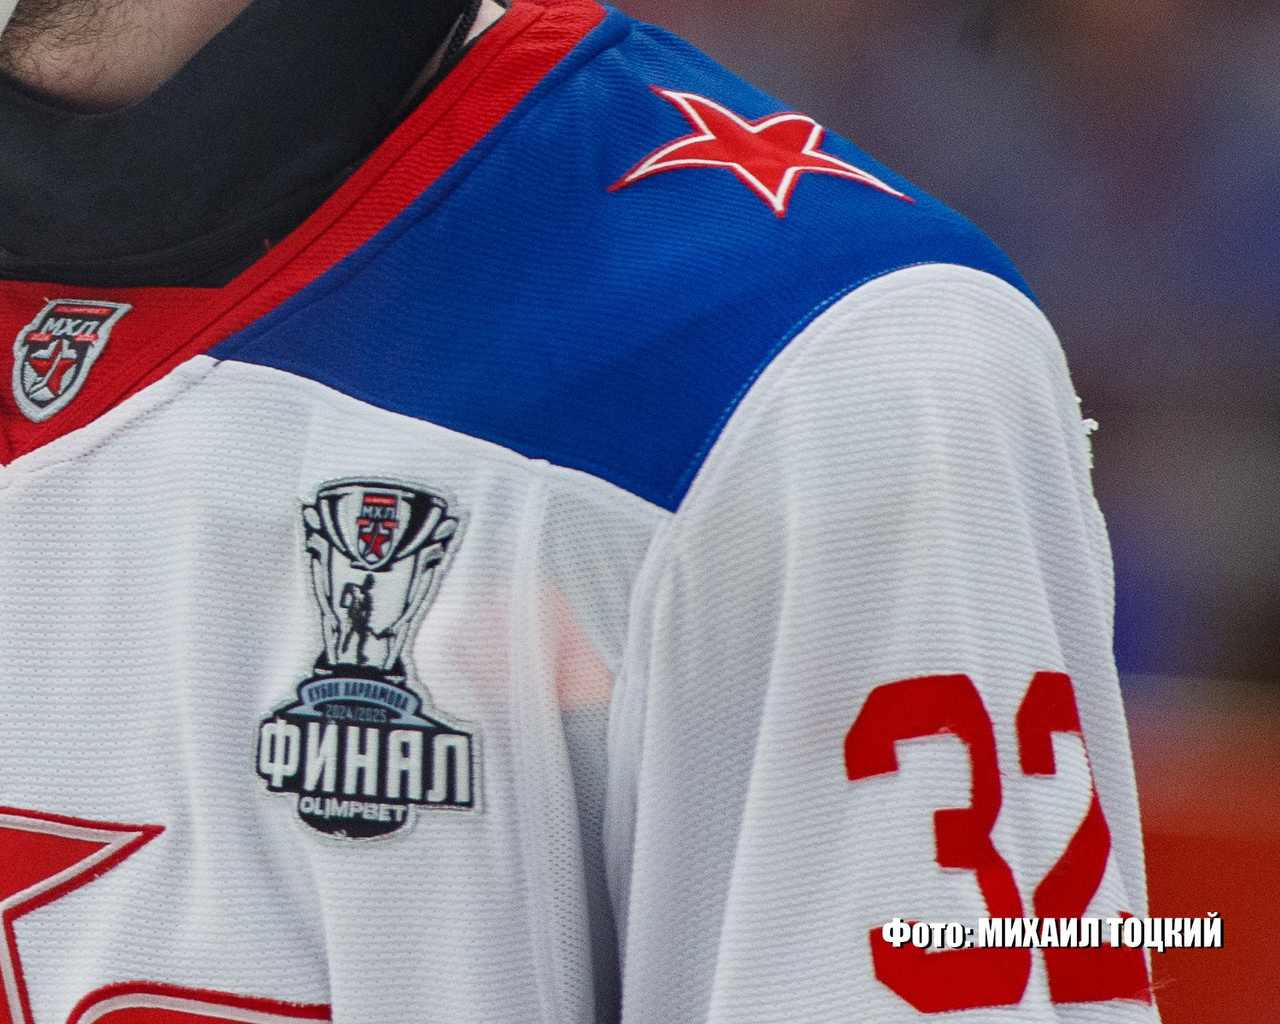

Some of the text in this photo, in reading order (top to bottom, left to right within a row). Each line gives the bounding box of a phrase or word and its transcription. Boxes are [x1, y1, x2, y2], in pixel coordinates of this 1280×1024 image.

[40, 318, 99, 335] МХЛ
[259, 718, 471, 804] ФИНАЛ
[300, 796, 408, 823] OLIMPBET
[843, 671, 1153, 1014] 32
